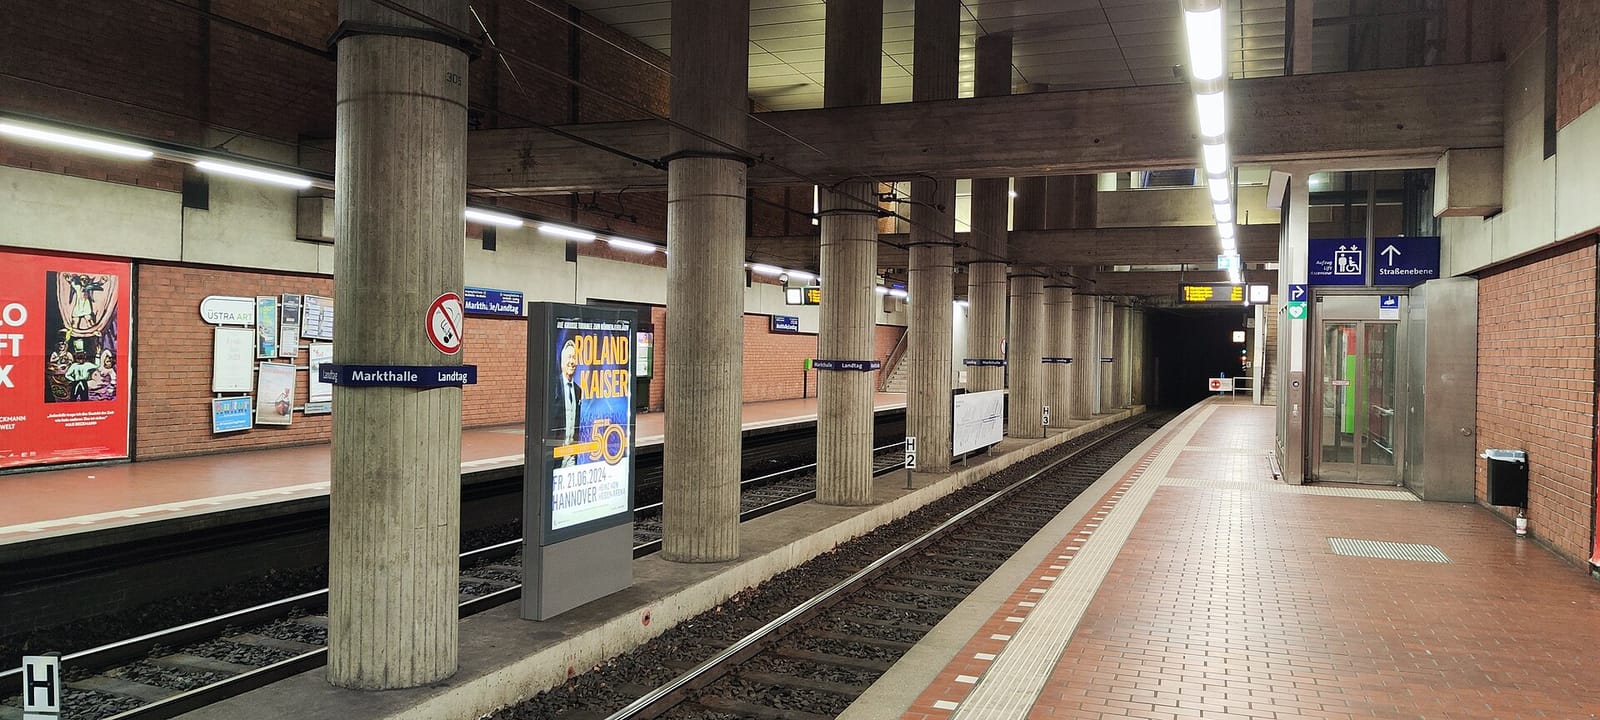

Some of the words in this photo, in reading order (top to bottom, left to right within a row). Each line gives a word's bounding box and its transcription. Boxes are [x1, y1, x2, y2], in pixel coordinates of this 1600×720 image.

[0, 303, 28, 327] O
[207, 309, 235, 320] ÜSTRA
[236, 313, 253, 321] ART
[574, 335, 629, 366] ROLAND
[841, 362, 863, 370] Landtag
[351, 371, 418, 382] Markthalle
[438, 372, 468, 384] Landtag
[580, 370, 629, 399] KAISER
[1043, 406, 1049, 415] H
[1043, 416, 1049, 424] 3
[589, 419, 626, 466] 50
[906, 438, 915, 451] H
[906, 454, 915, 467] 2
[552, 474, 565, 492] FR.
[567, 467, 607, 489] 21.06.2024
[552, 486, 598, 511] HANNOVER
[27, 663, 55, 707] H
